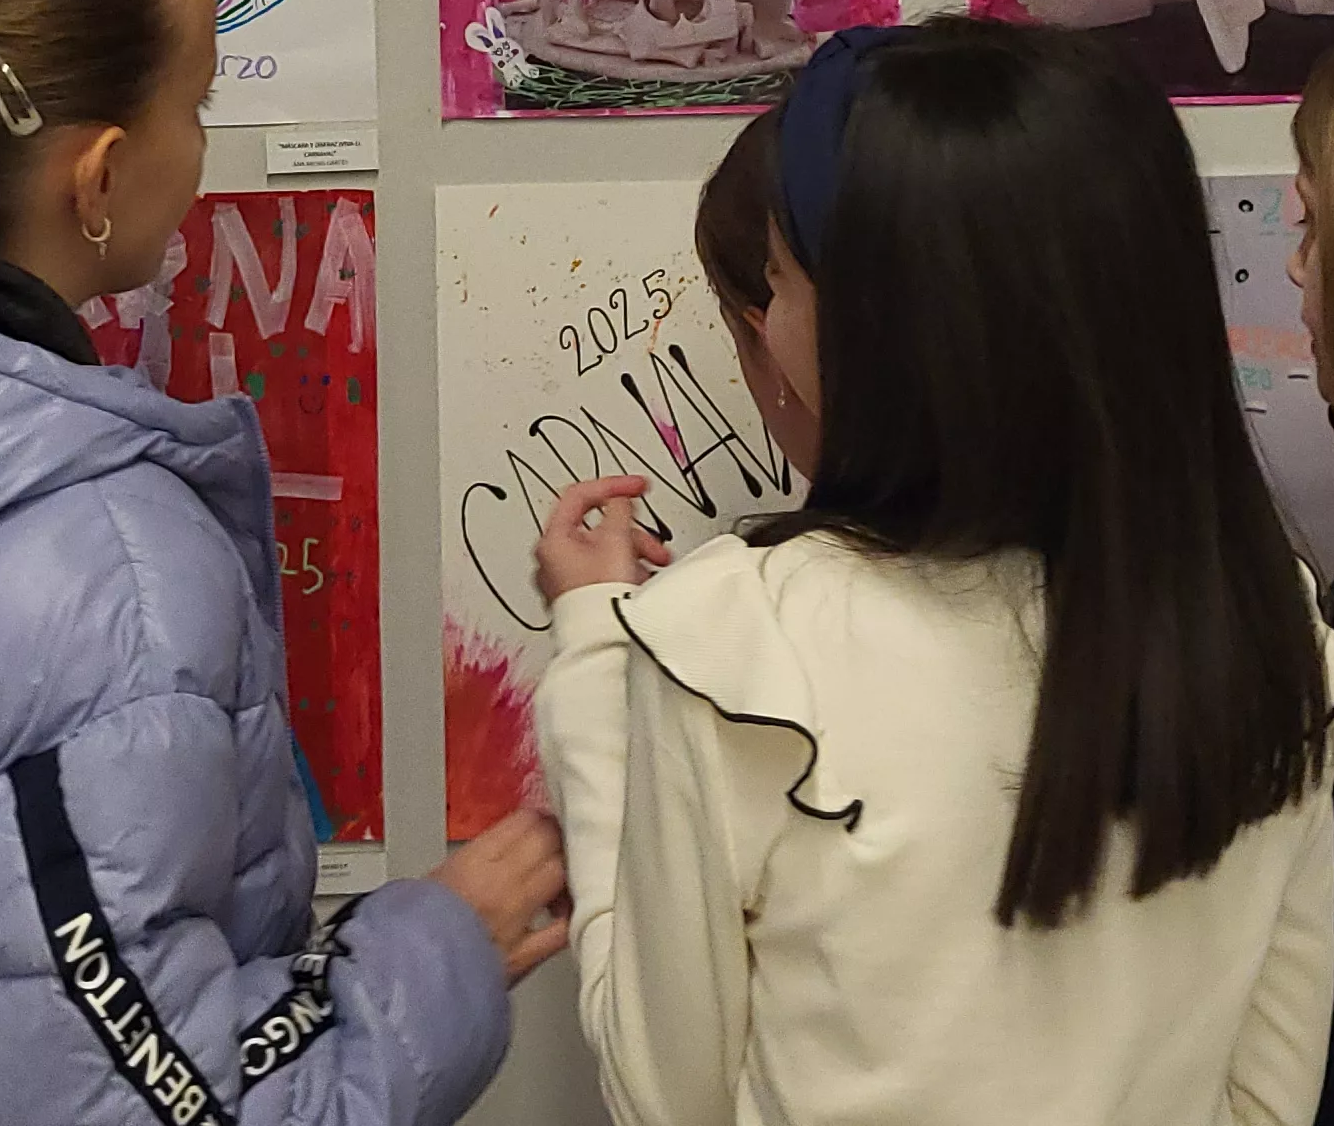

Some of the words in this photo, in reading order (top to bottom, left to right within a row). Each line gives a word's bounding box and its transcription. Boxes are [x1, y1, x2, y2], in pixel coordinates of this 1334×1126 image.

[214, 54, 278, 79] rzo
[558, 268, 674, 377] 2025
[277, 538, 325, 596] 25
[54, 912, 208, 1126] BENETTON
